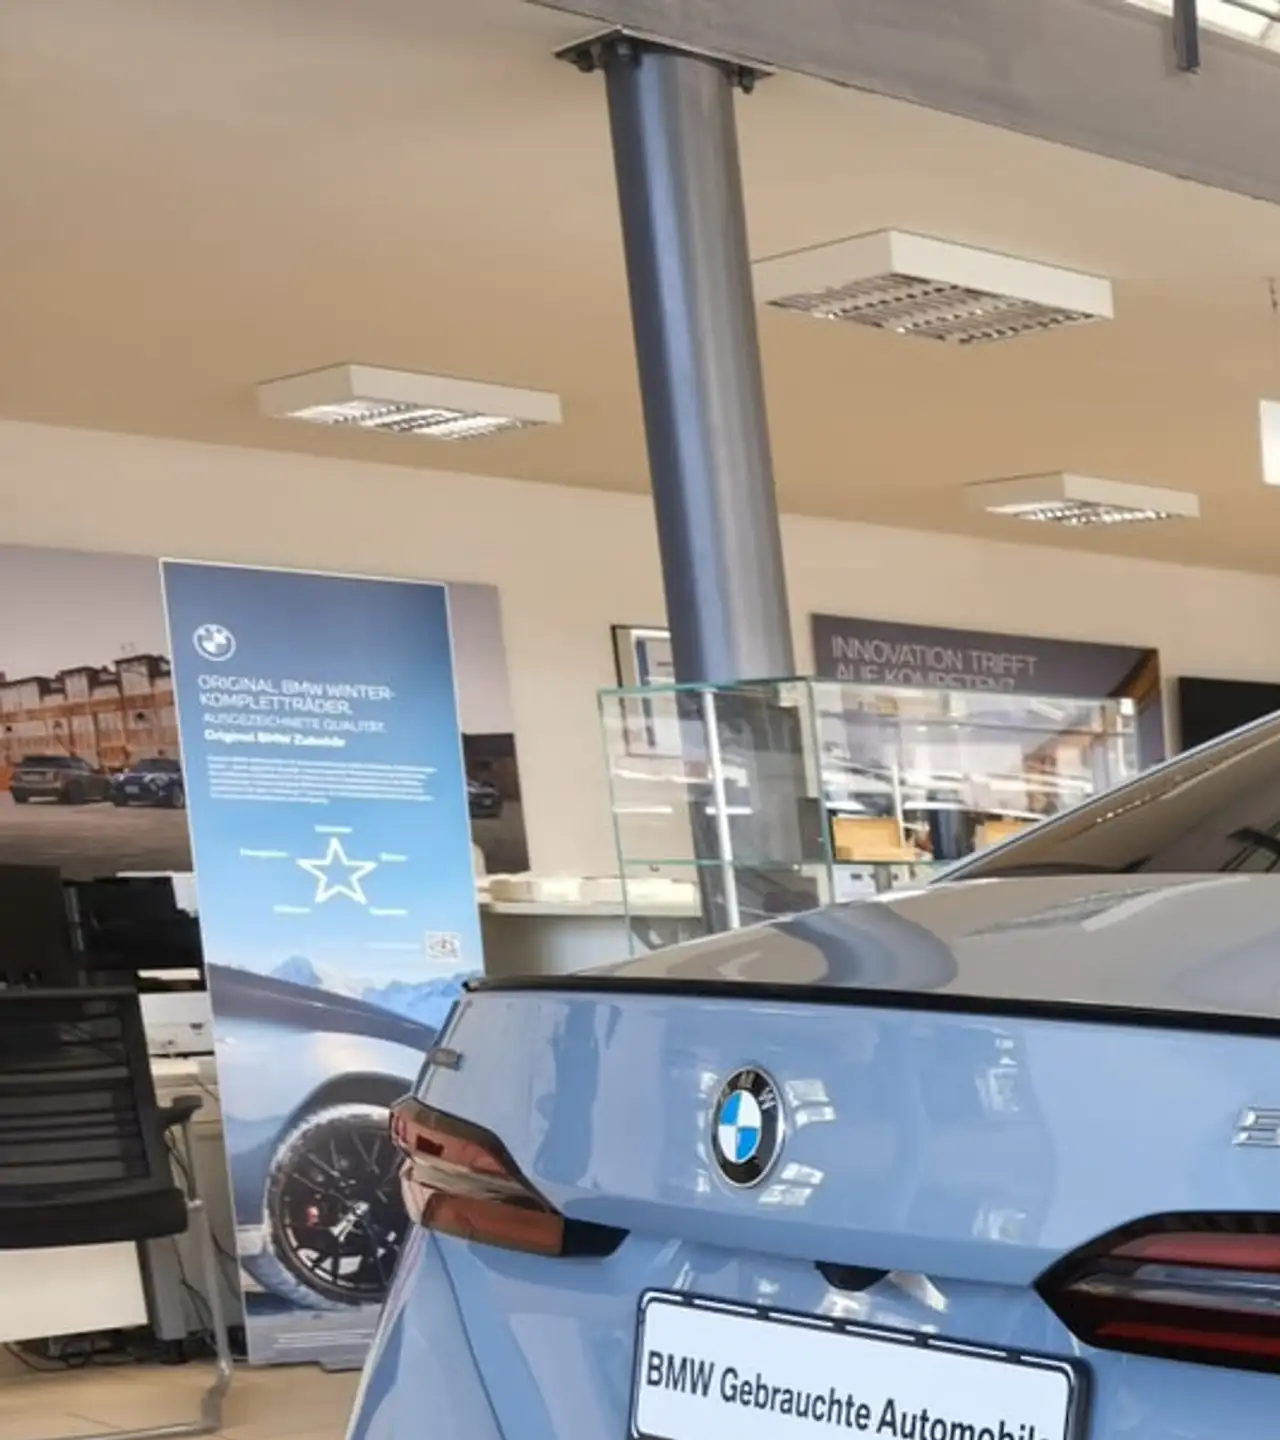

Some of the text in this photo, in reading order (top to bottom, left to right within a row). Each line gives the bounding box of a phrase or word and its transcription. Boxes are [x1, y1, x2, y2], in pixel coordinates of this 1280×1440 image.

[831, 635, 1039, 677] INNOVATION TRIFFT
[197, 674, 396, 701] ORIGINAL BMW WINTER-
[645, 1350, 714, 1398] BMW
[719, 1367, 871, 1432] Gebrauchte
